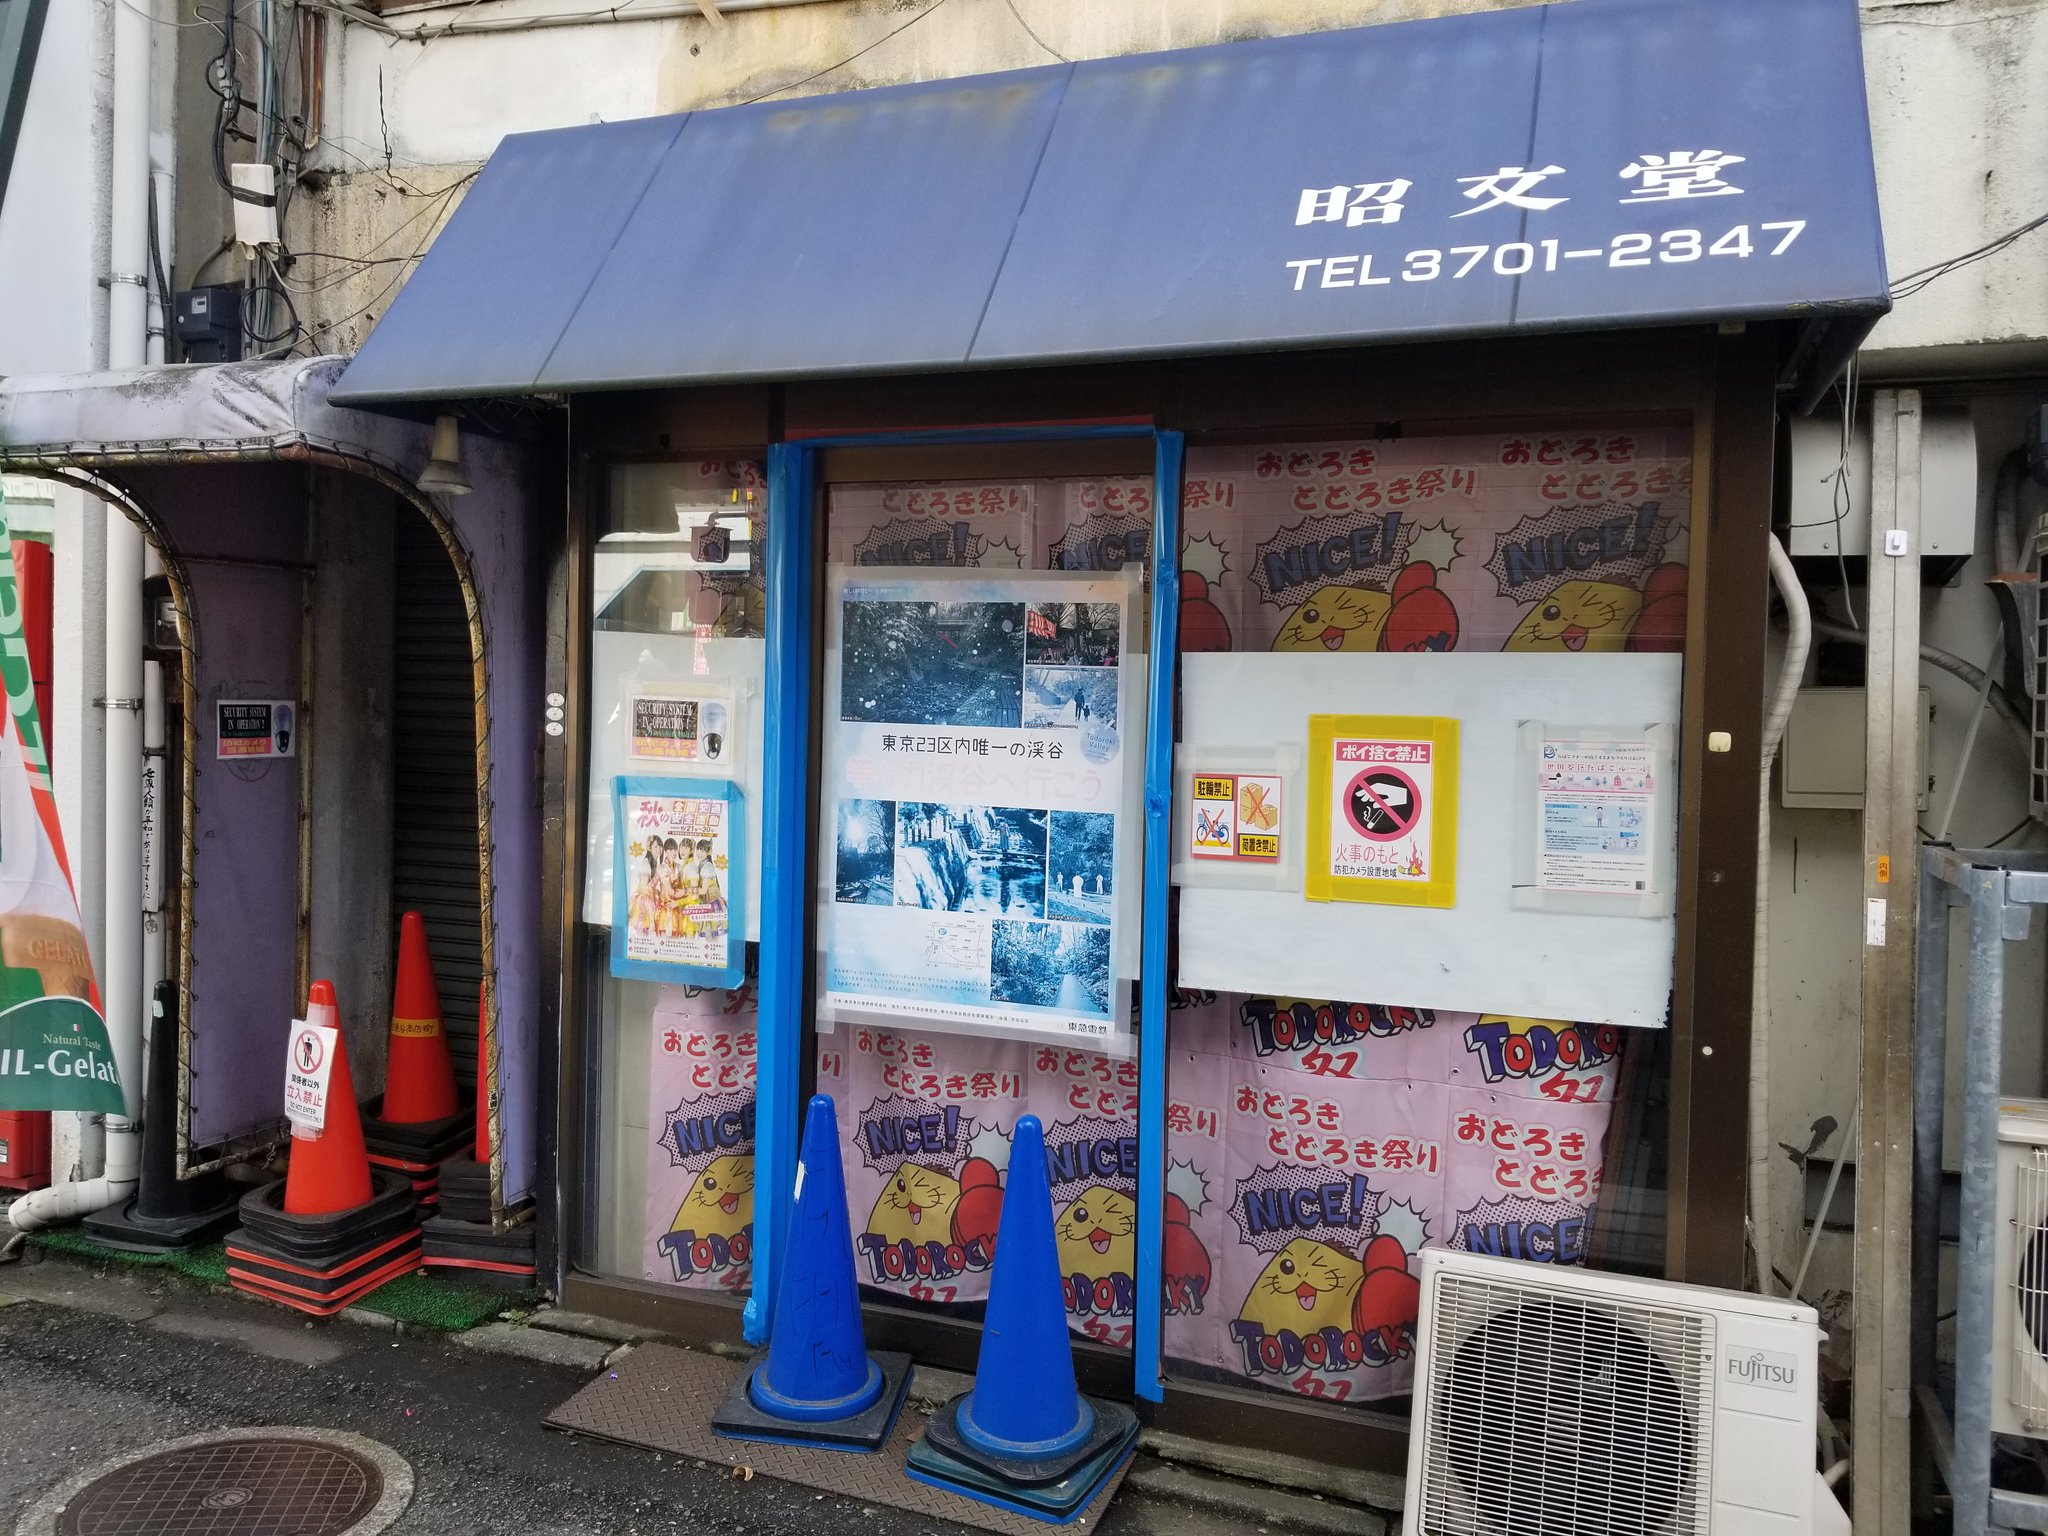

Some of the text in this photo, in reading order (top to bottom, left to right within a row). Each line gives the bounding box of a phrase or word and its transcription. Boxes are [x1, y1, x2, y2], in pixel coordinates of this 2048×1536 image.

[1294, 149, 1745, 227] 昭文堂
[1286, 219, 1806, 291] TEL 3701-2347
[1256, 450, 1378, 478] おどろき
[1501, 437, 1635, 466] おどろき
[1292, 468, 1476, 510] とどろき祭り
[1265, 514, 1402, 592] NICE!
[1504, 500, 1660, 588] NICE!
[224, 706, 267, 719] SECURITY SYSTEM
[639, 701, 694, 718] SECURITY SYSTEM
[237, 720, 261, 731] OPERATION
[882, 734, 1064, 760] 東京23区内唯一の渓谷
[1086, 732, 1116, 746] Todoroki
[1089, 741, 1110, 753] Valley
[1342, 745, 1427, 763] ポイ捨て禁止
[1197, 781, 1230, 797] 駐輪禁止
[1241, 837, 1276, 854] 荷置き禁止
[1335, 842, 1399, 865] 火事のもと
[1333, 864, 1398, 879] 防犯カメラ設置地域
[43, 1034, 80, 1047] Natural
[1068, 1021, 1108, 1035] 東急電鉄
[858, 1030, 933, 1066] おどろき
[291, 1073, 321, 1092] 関係者以外
[883, 1063, 1021, 1101] とどろき祭り
[287, 1085, 324, 1109] 立入禁止
[1235, 1085, 1341, 1130] おどろき
[309, 1105, 324, 1116] ENTER
[866, 1105, 969, 1161] NICE!
[1456, 1112, 1586, 1160] おどろき
[1266, 1128, 1439, 1173] とどろき祭り
[1245, 1173, 1369, 1237] NICE!
[1728, 1353, 1796, 1384] FUJITSU
